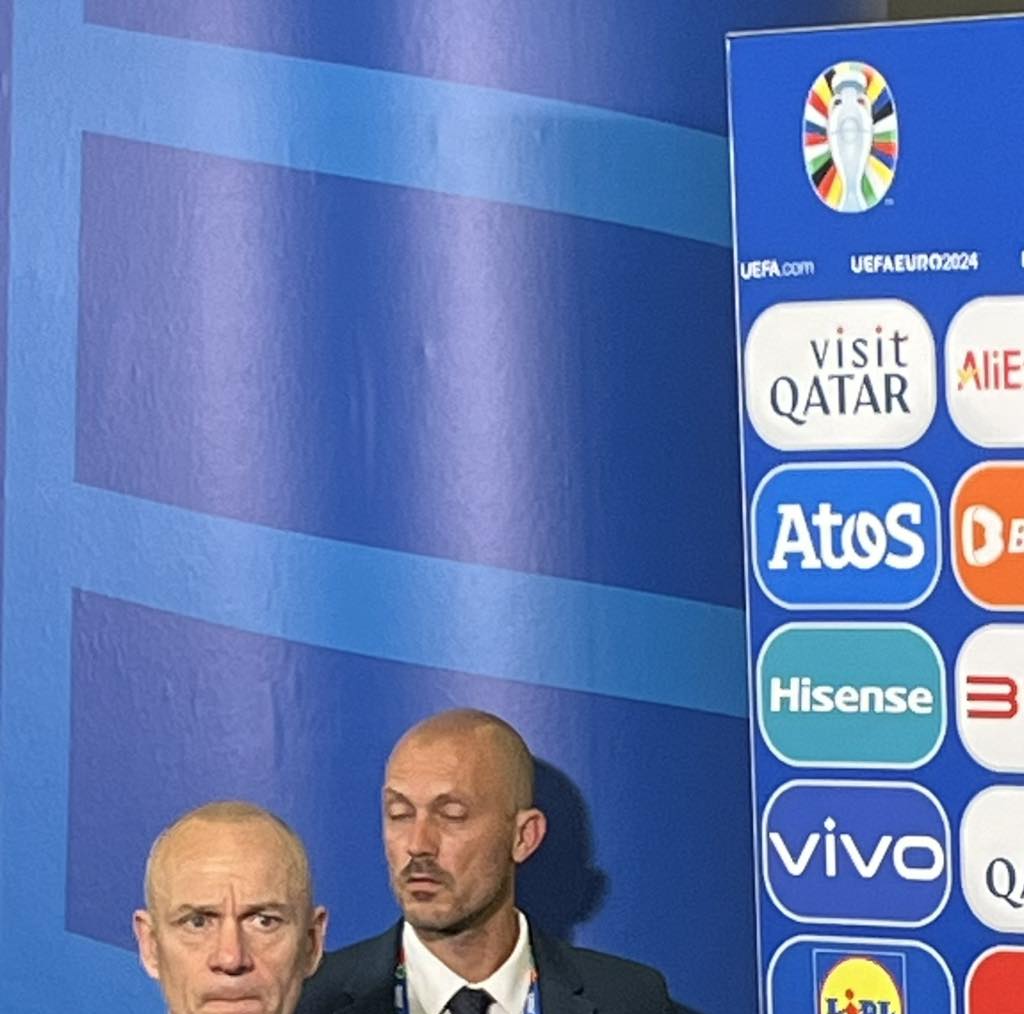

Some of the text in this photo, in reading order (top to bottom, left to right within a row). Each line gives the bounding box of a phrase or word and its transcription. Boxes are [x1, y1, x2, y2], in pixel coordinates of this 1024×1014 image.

[740, 260, 815, 280] UEFA.com
[850, 251, 979, 273] UEFAEURO2024
[810, 326, 909, 368] visit
[770, 374, 911, 424] QATAR
[768, 502, 925, 570] Atos
[770, 677, 933, 713] Hisense
[769, 816, 945, 881] vivo
